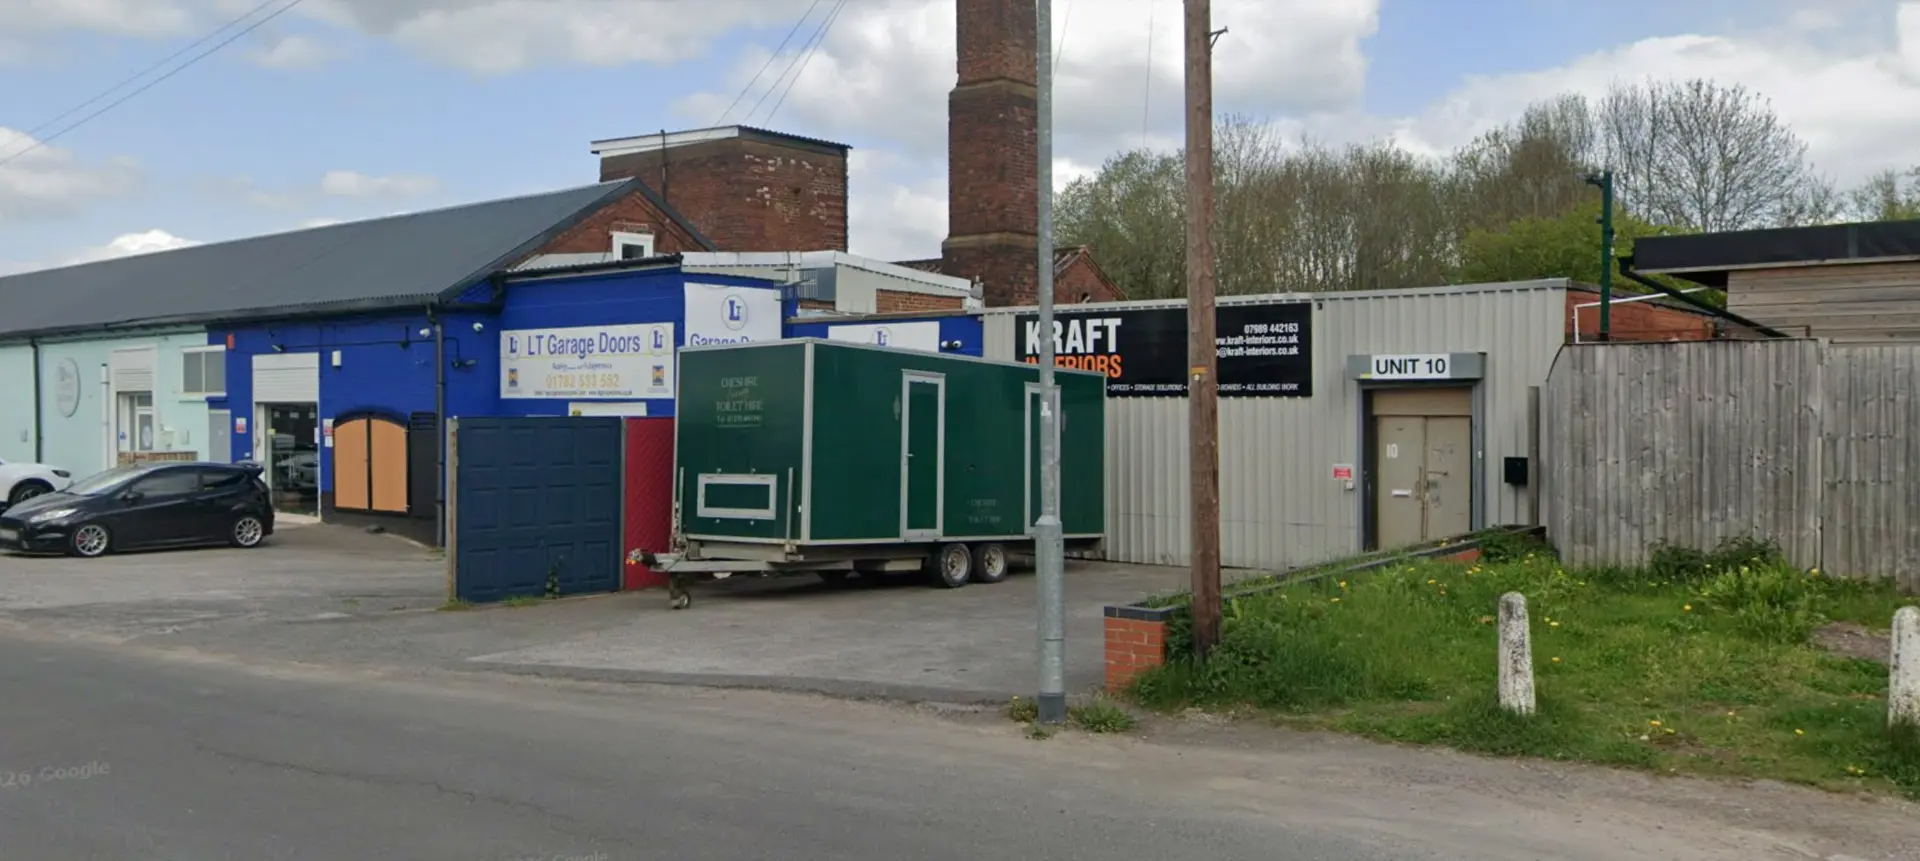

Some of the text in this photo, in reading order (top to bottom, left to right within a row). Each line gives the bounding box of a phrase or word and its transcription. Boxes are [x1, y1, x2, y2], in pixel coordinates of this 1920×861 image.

[1025, 317, 1122, 355] KRAFT
[1244, 323, 1268, 334] 07989
[527, 332, 641, 359] LT Garage Doors
[1376, 358, 1446, 375] UNIT 10
[1386, 443, 1399, 459] 10
